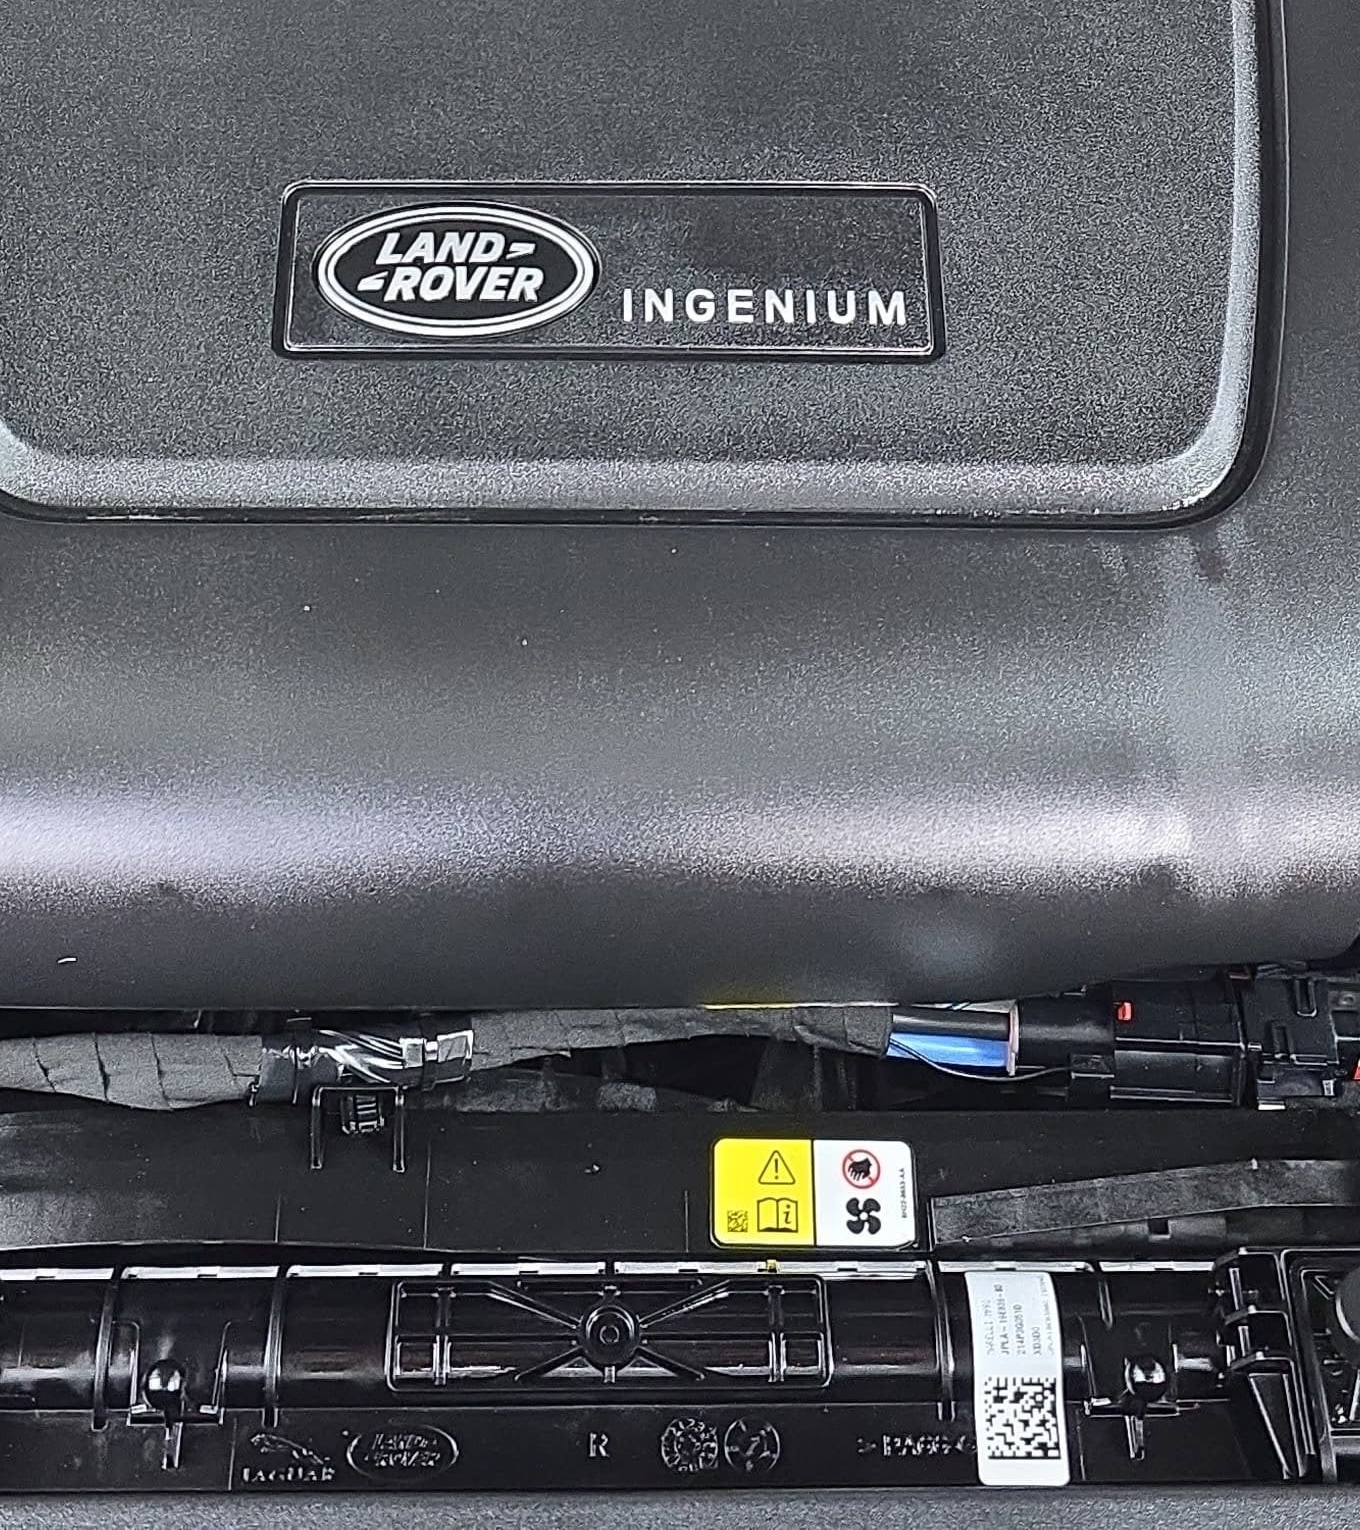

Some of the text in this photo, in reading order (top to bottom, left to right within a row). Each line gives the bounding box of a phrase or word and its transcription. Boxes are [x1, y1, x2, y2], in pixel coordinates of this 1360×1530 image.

[375, 231, 508, 264] LAND
[382, 266, 544, 303] ROVER
[622, 288, 907, 326] INGENIUM
